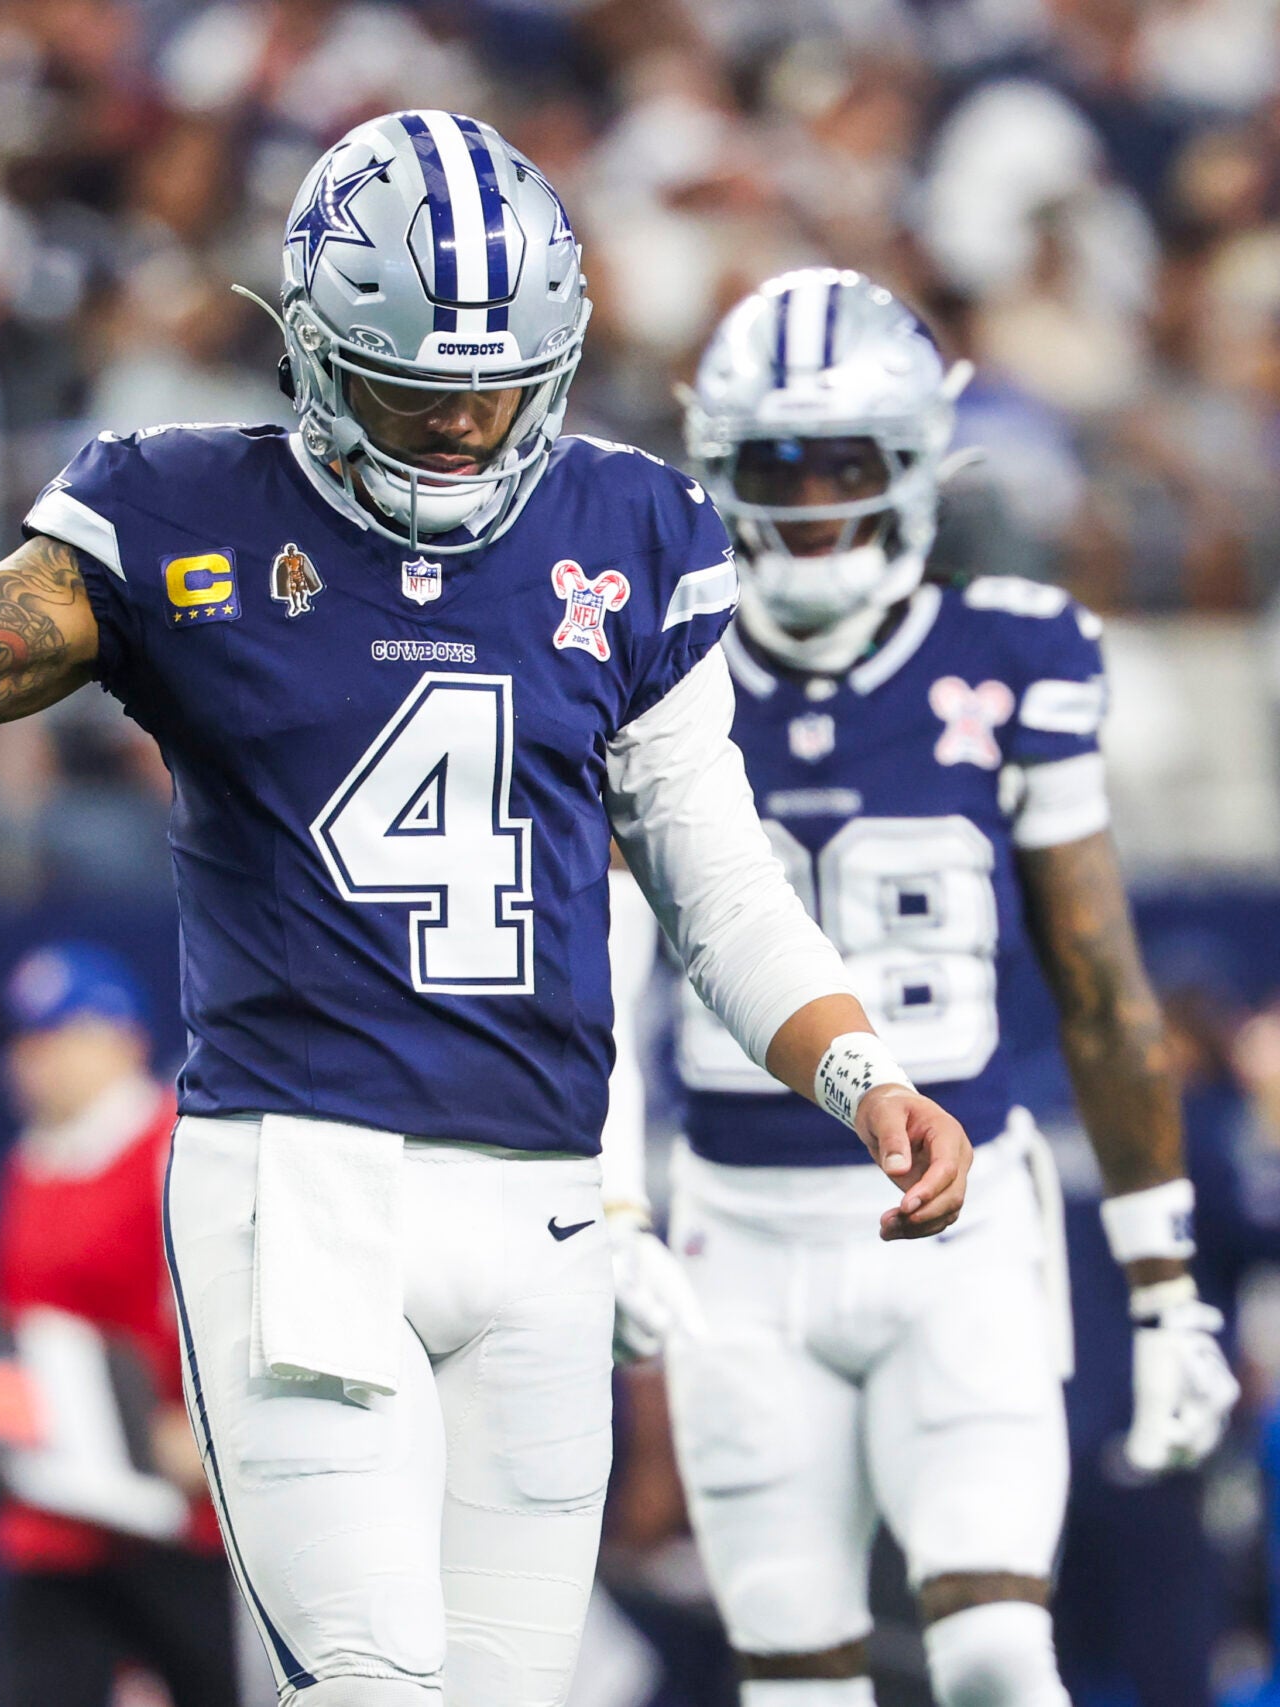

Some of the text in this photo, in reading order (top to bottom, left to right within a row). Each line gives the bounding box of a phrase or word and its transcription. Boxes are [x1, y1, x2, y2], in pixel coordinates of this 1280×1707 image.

[437, 342, 504, 356] COWBOYS
[165, 553, 233, 608] C
[409, 577, 435, 593] NFL
[572, 604, 597, 627] NFL
[371, 640, 476, 663] COWBOYS
[572, 634, 590, 646] 2025
[308, 671, 535, 995] 4
[824, 1076, 852, 1115] FAITH
